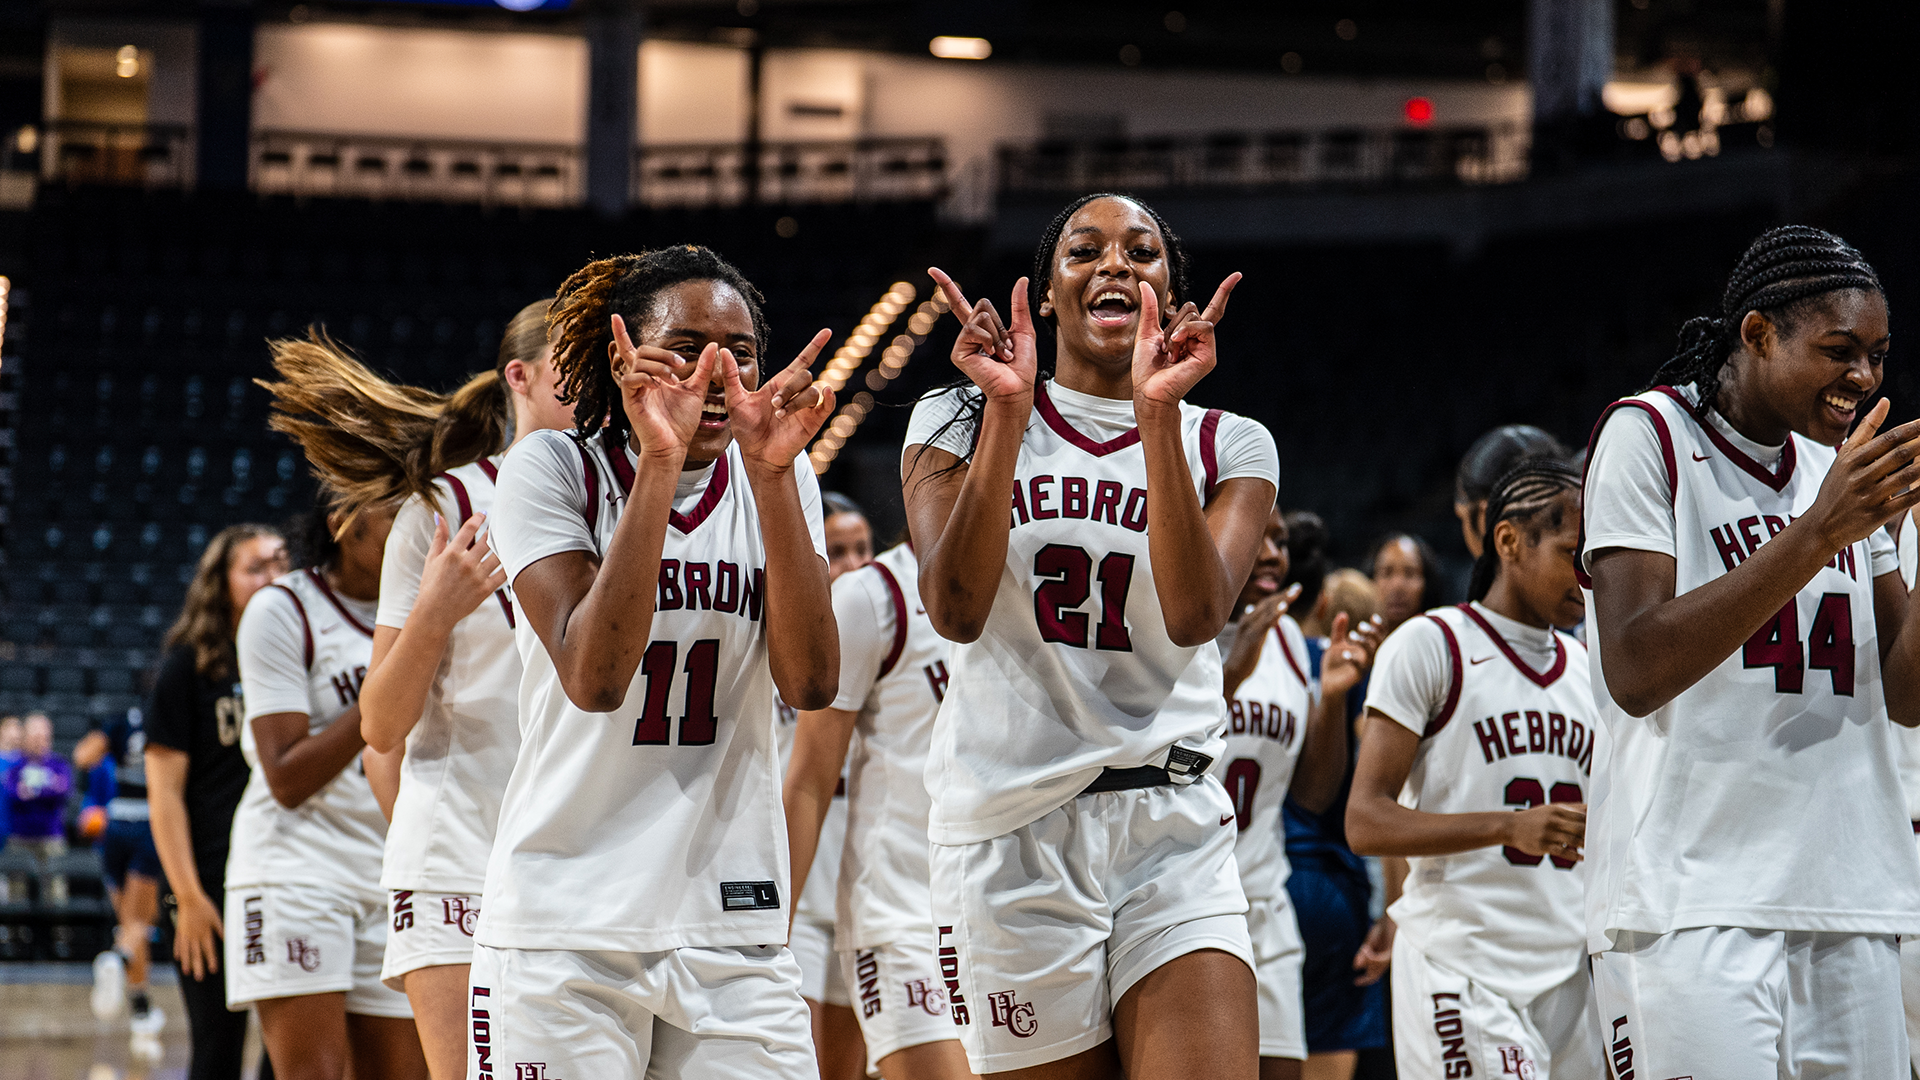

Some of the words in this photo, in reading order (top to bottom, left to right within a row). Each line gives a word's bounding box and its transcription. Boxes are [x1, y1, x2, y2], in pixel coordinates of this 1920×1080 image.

[1010, 475, 1149, 536] HEBRO
[654, 559, 763, 621] BRON
[1034, 543, 1135, 652] 21
[1742, 592, 1856, 697] 44
[632, 639, 720, 746] 11
[1219, 700, 1296, 750] BRON
[761, 889, 770, 900] L
[244, 896, 266, 967] LIONS
[938, 925, 970, 1026] LIONS
[988, 990, 1038, 1038] HC
[1431, 992, 1473, 1080] LIONS
[1612, 1014, 1635, 1080] LIO
